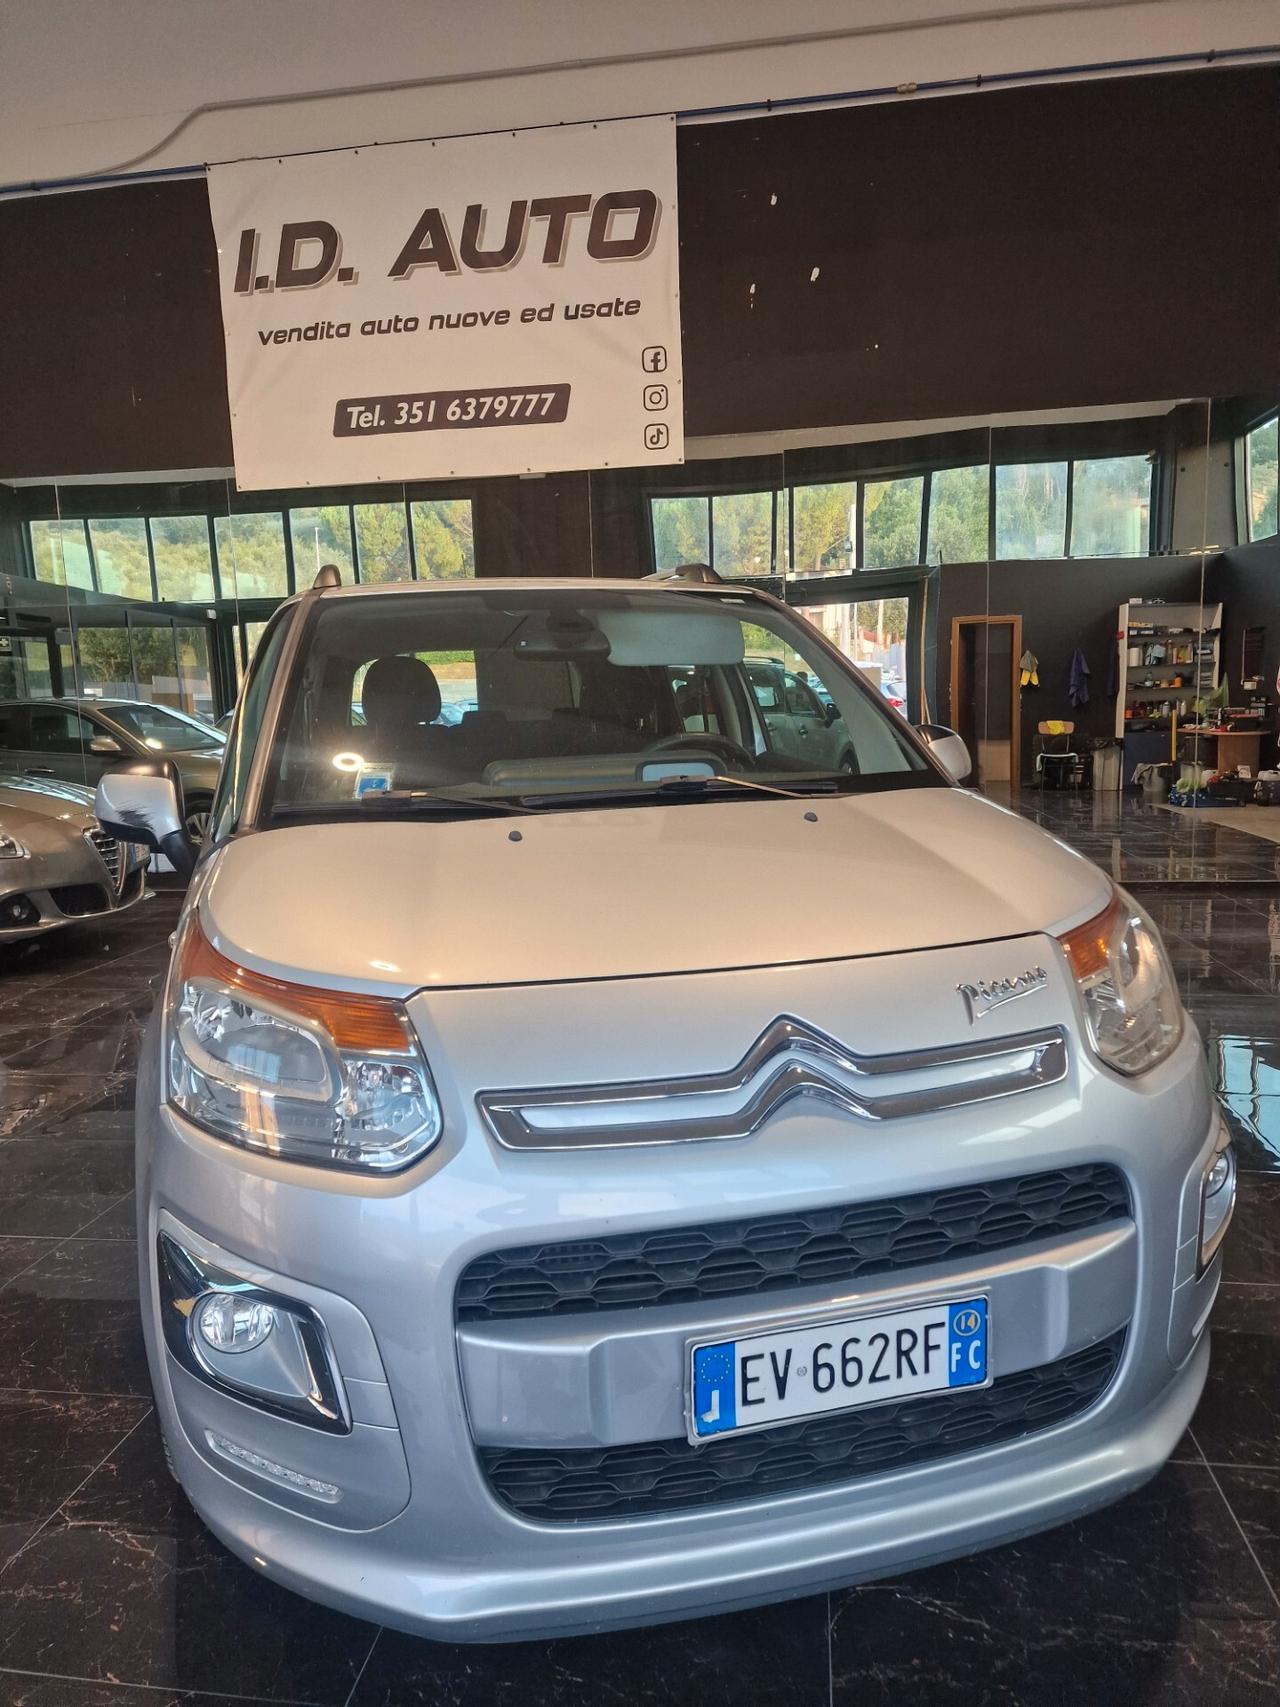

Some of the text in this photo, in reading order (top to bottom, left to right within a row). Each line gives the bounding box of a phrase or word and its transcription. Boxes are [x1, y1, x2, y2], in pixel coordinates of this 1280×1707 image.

[234, 189, 663, 296] I.D. AUTO
[257, 298, 641, 345] vendita auto nuove ed usate
[347, 393, 556, 428] Tel. 351 6379777
[740, 1321, 946, 1407] EV 662RF
